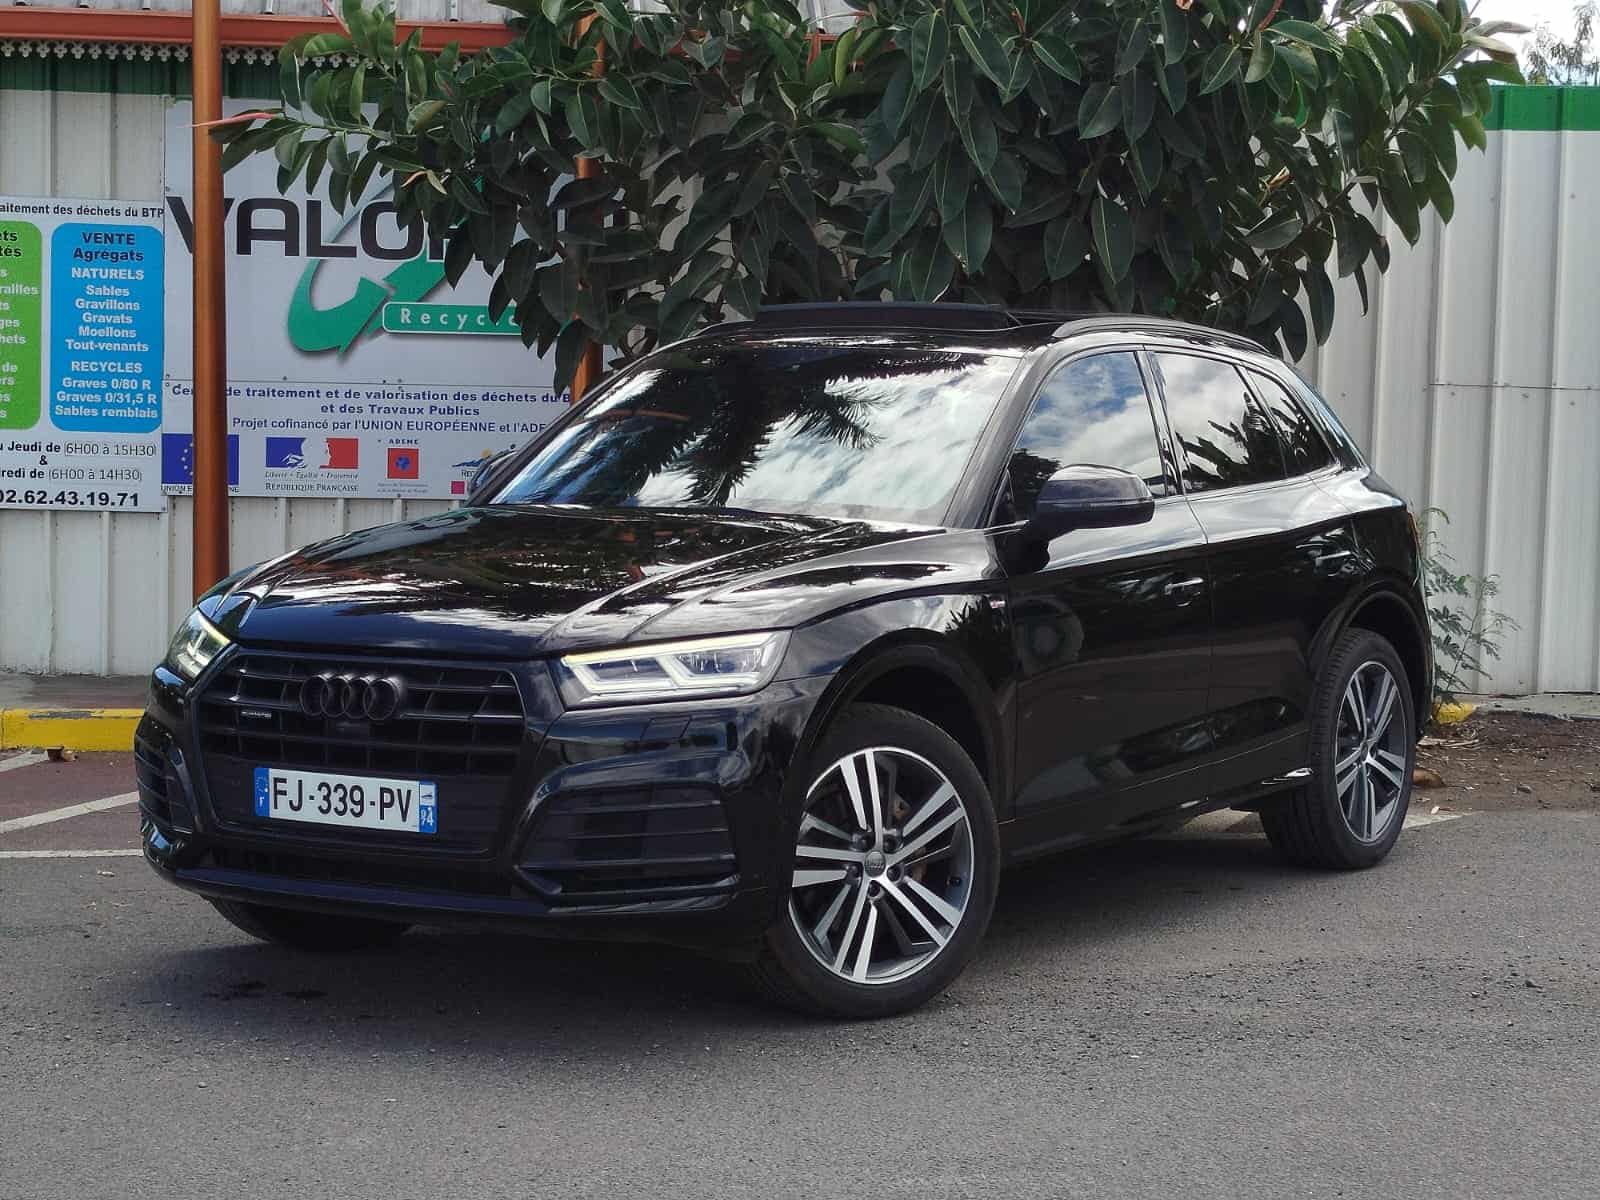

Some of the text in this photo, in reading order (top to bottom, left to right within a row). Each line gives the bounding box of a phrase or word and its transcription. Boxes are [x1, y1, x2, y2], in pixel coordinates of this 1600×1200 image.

[53, 204, 73, 215] des
[76, 205, 121, 216] déchets
[124, 206, 138, 217] du
[142, 207, 164, 218] BTP
[82, 231, 136, 245] VENTE
[73, 247, 144, 263] Agrégats
[71, 267, 145, 280] NATURELS
[86, 285, 130, 297] Sables
[75, 298, 141, 311] Gravillons
[82, 312, 133, 324] Gravats
[78, 326, 137, 338] Moellons
[65, 339, 149, 352] Tout-venants
[71, 361, 143, 374] RECYCLES
[62, 377, 151, 390] Graves 0/80 R
[56, 391, 157, 404] Graves 0/31,5 R
[246, 387, 321, 399] traitement
[326, 389, 339, 399] et
[344, 389, 360, 399] de
[365, 390, 448, 401] valorisation
[453, 391, 477, 401] des
[482, 392, 537, 403] déchets
[55, 405, 158, 418] Sables remblais
[321, 403, 480, 416] et des Travaux Publics
[233, 417, 267, 431] Projet
[272, 417, 328, 429] cofinancé
[332, 420, 351, 431] par
[355, 419, 402, 431] l'UNION
[407, 418, 495, 432] EUROPÉENNE
[499, 423, 510, 433] et
[8, 441, 41, 453] Jeudi
[46, 442, 61, 453] de
[103, 444, 109, 455] à
[39, 455, 48, 465] &
[30, 468, 44, 479] de
[88, 469, 95, 480] à
[273, 777, 412, 823] FJ-339-PV
